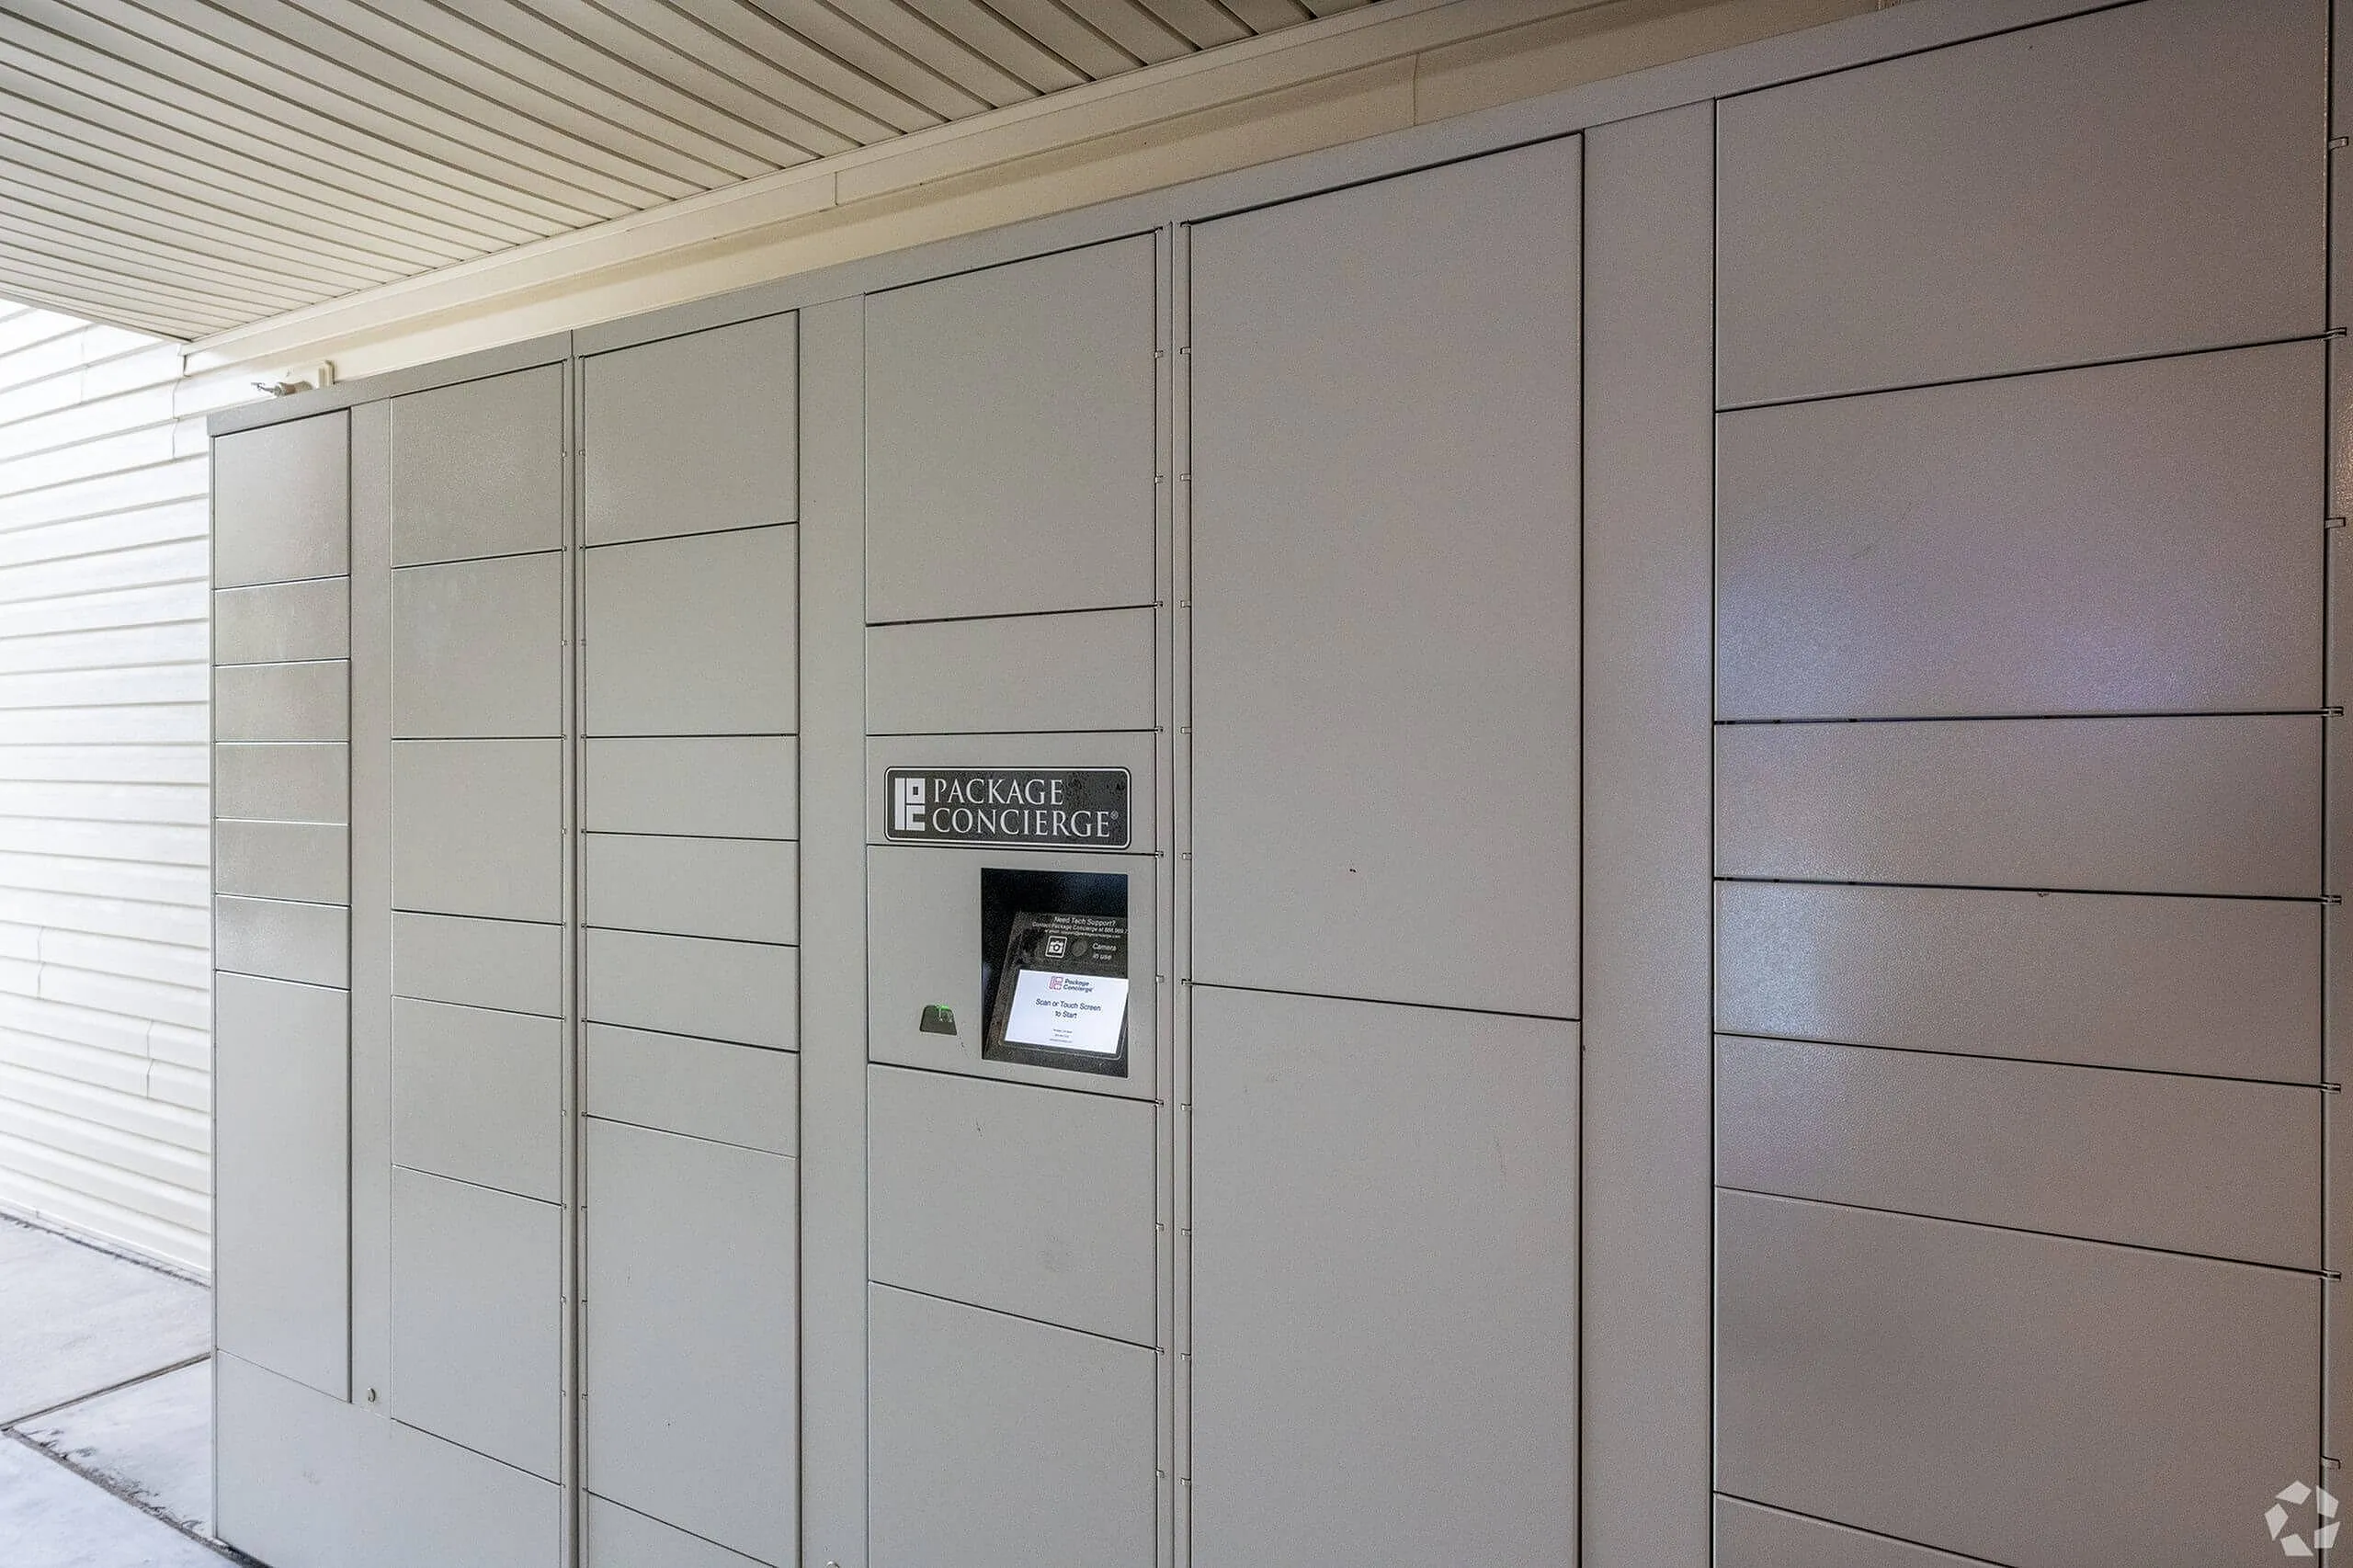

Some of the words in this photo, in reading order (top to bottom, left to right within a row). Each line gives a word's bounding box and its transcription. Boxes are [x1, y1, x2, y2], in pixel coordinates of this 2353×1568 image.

[933, 778, 1063, 805] PACKAGE
[1092, 942, 1117, 951] Camera
[1064, 978, 1089, 986] Package
[1063, 984, 1092, 993] Concierge
[1035, 998, 1051, 1006] Scan
[1060, 1000, 1078, 1009] Touch
[1079, 1003, 1101, 1011] Screen
[1063, 1010, 1077, 1018] Start
